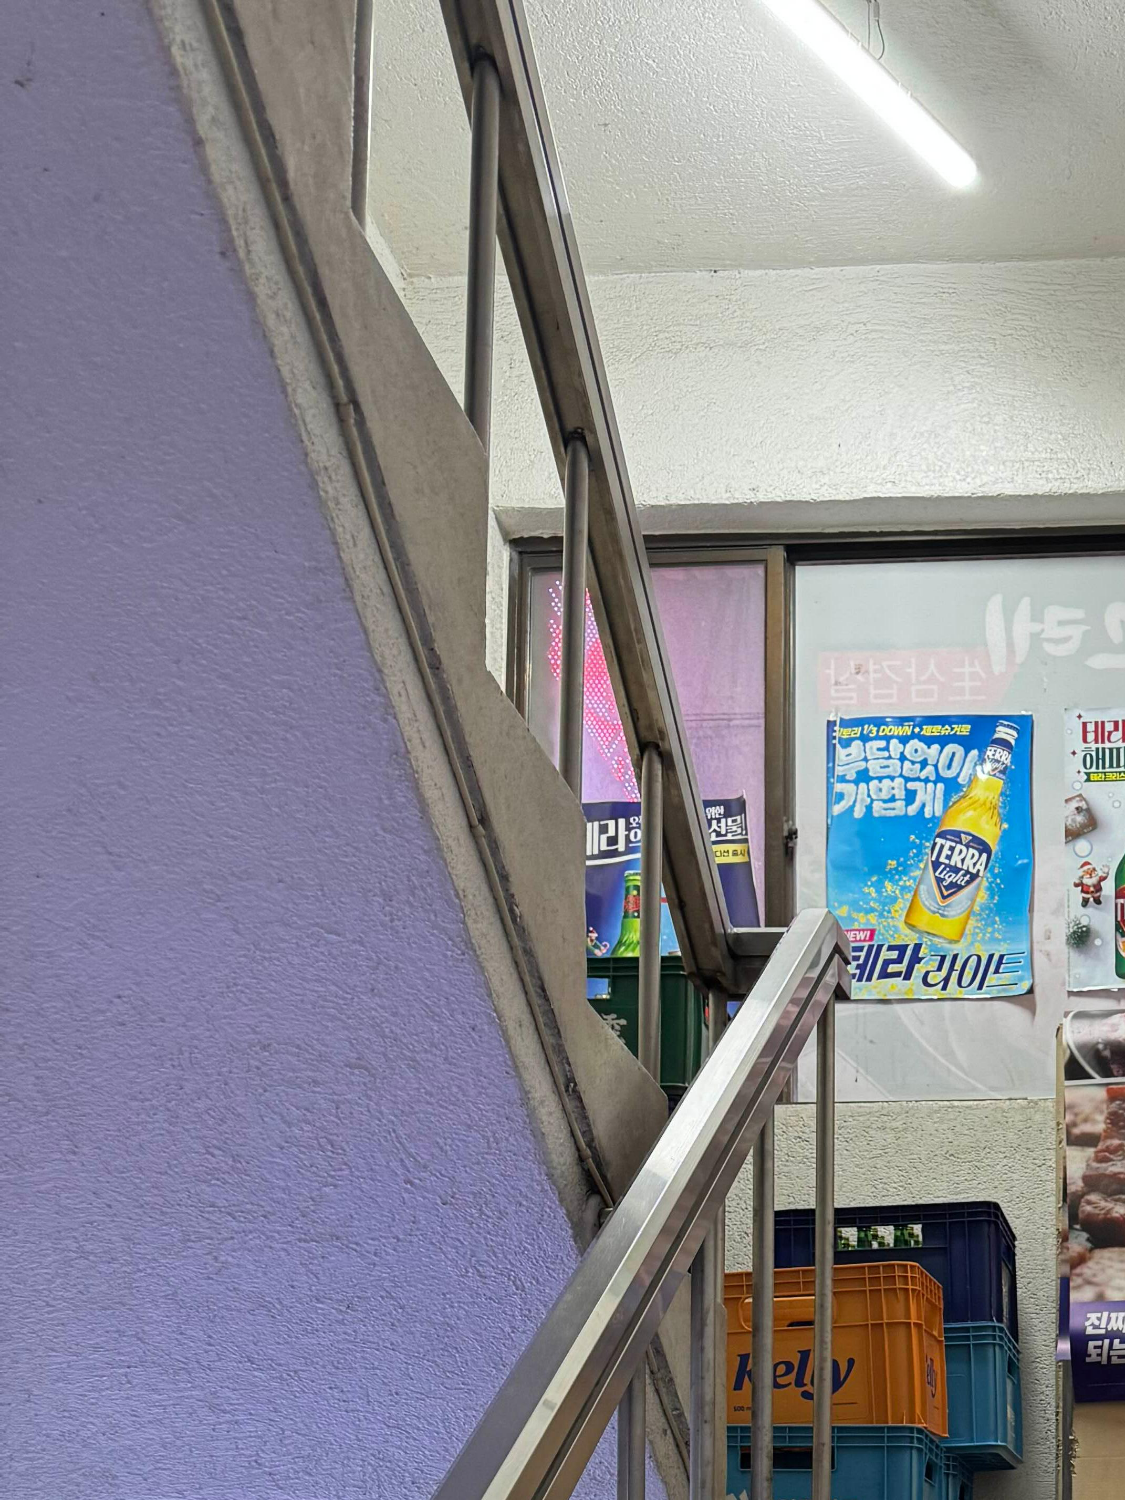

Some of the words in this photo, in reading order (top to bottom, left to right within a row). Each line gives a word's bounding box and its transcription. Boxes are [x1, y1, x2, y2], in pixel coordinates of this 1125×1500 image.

[879, 726, 913, 736] DOWN
[921, 725, 971, 736] 제로슈거로
[836, 738, 979, 784] 부담없이
[832, 779, 945, 818] 가볍게
[931, 838, 988, 878] TERRA
[935, 865, 972, 887] Light
[733, 1348, 855, 1401] Kely
